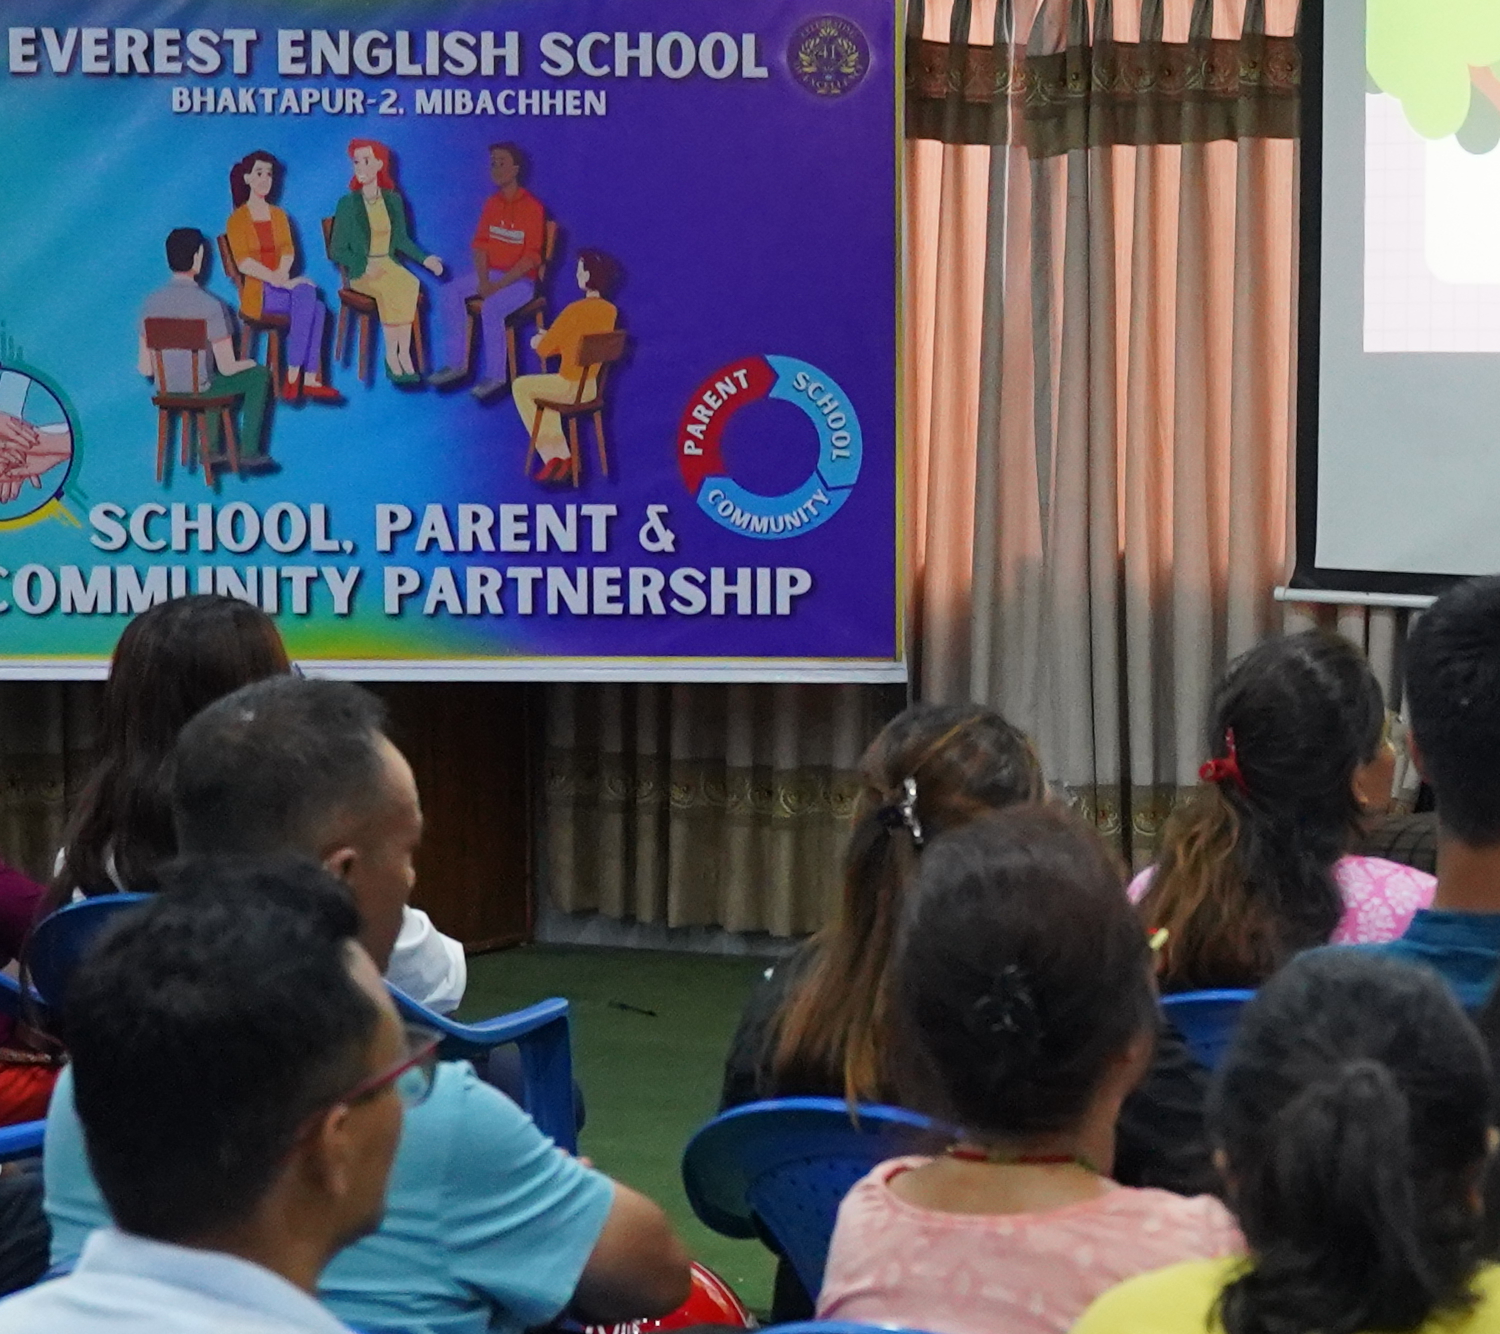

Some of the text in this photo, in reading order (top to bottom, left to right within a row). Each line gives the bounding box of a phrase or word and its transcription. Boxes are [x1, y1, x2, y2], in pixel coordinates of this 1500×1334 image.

[8, 26, 769, 80] EVEREST ENGLISH SCHOOL
[415, 88, 607, 117] MIBACHHEN
[683, 369, 748, 456] PARENT
[792, 371, 851, 462] SCHOOL
[88, 501, 676, 555] SCHOOL, PARENT &
[708, 488, 830, 534] COMMUNITY
[383, 565, 813, 616] PARTNERSHIP
